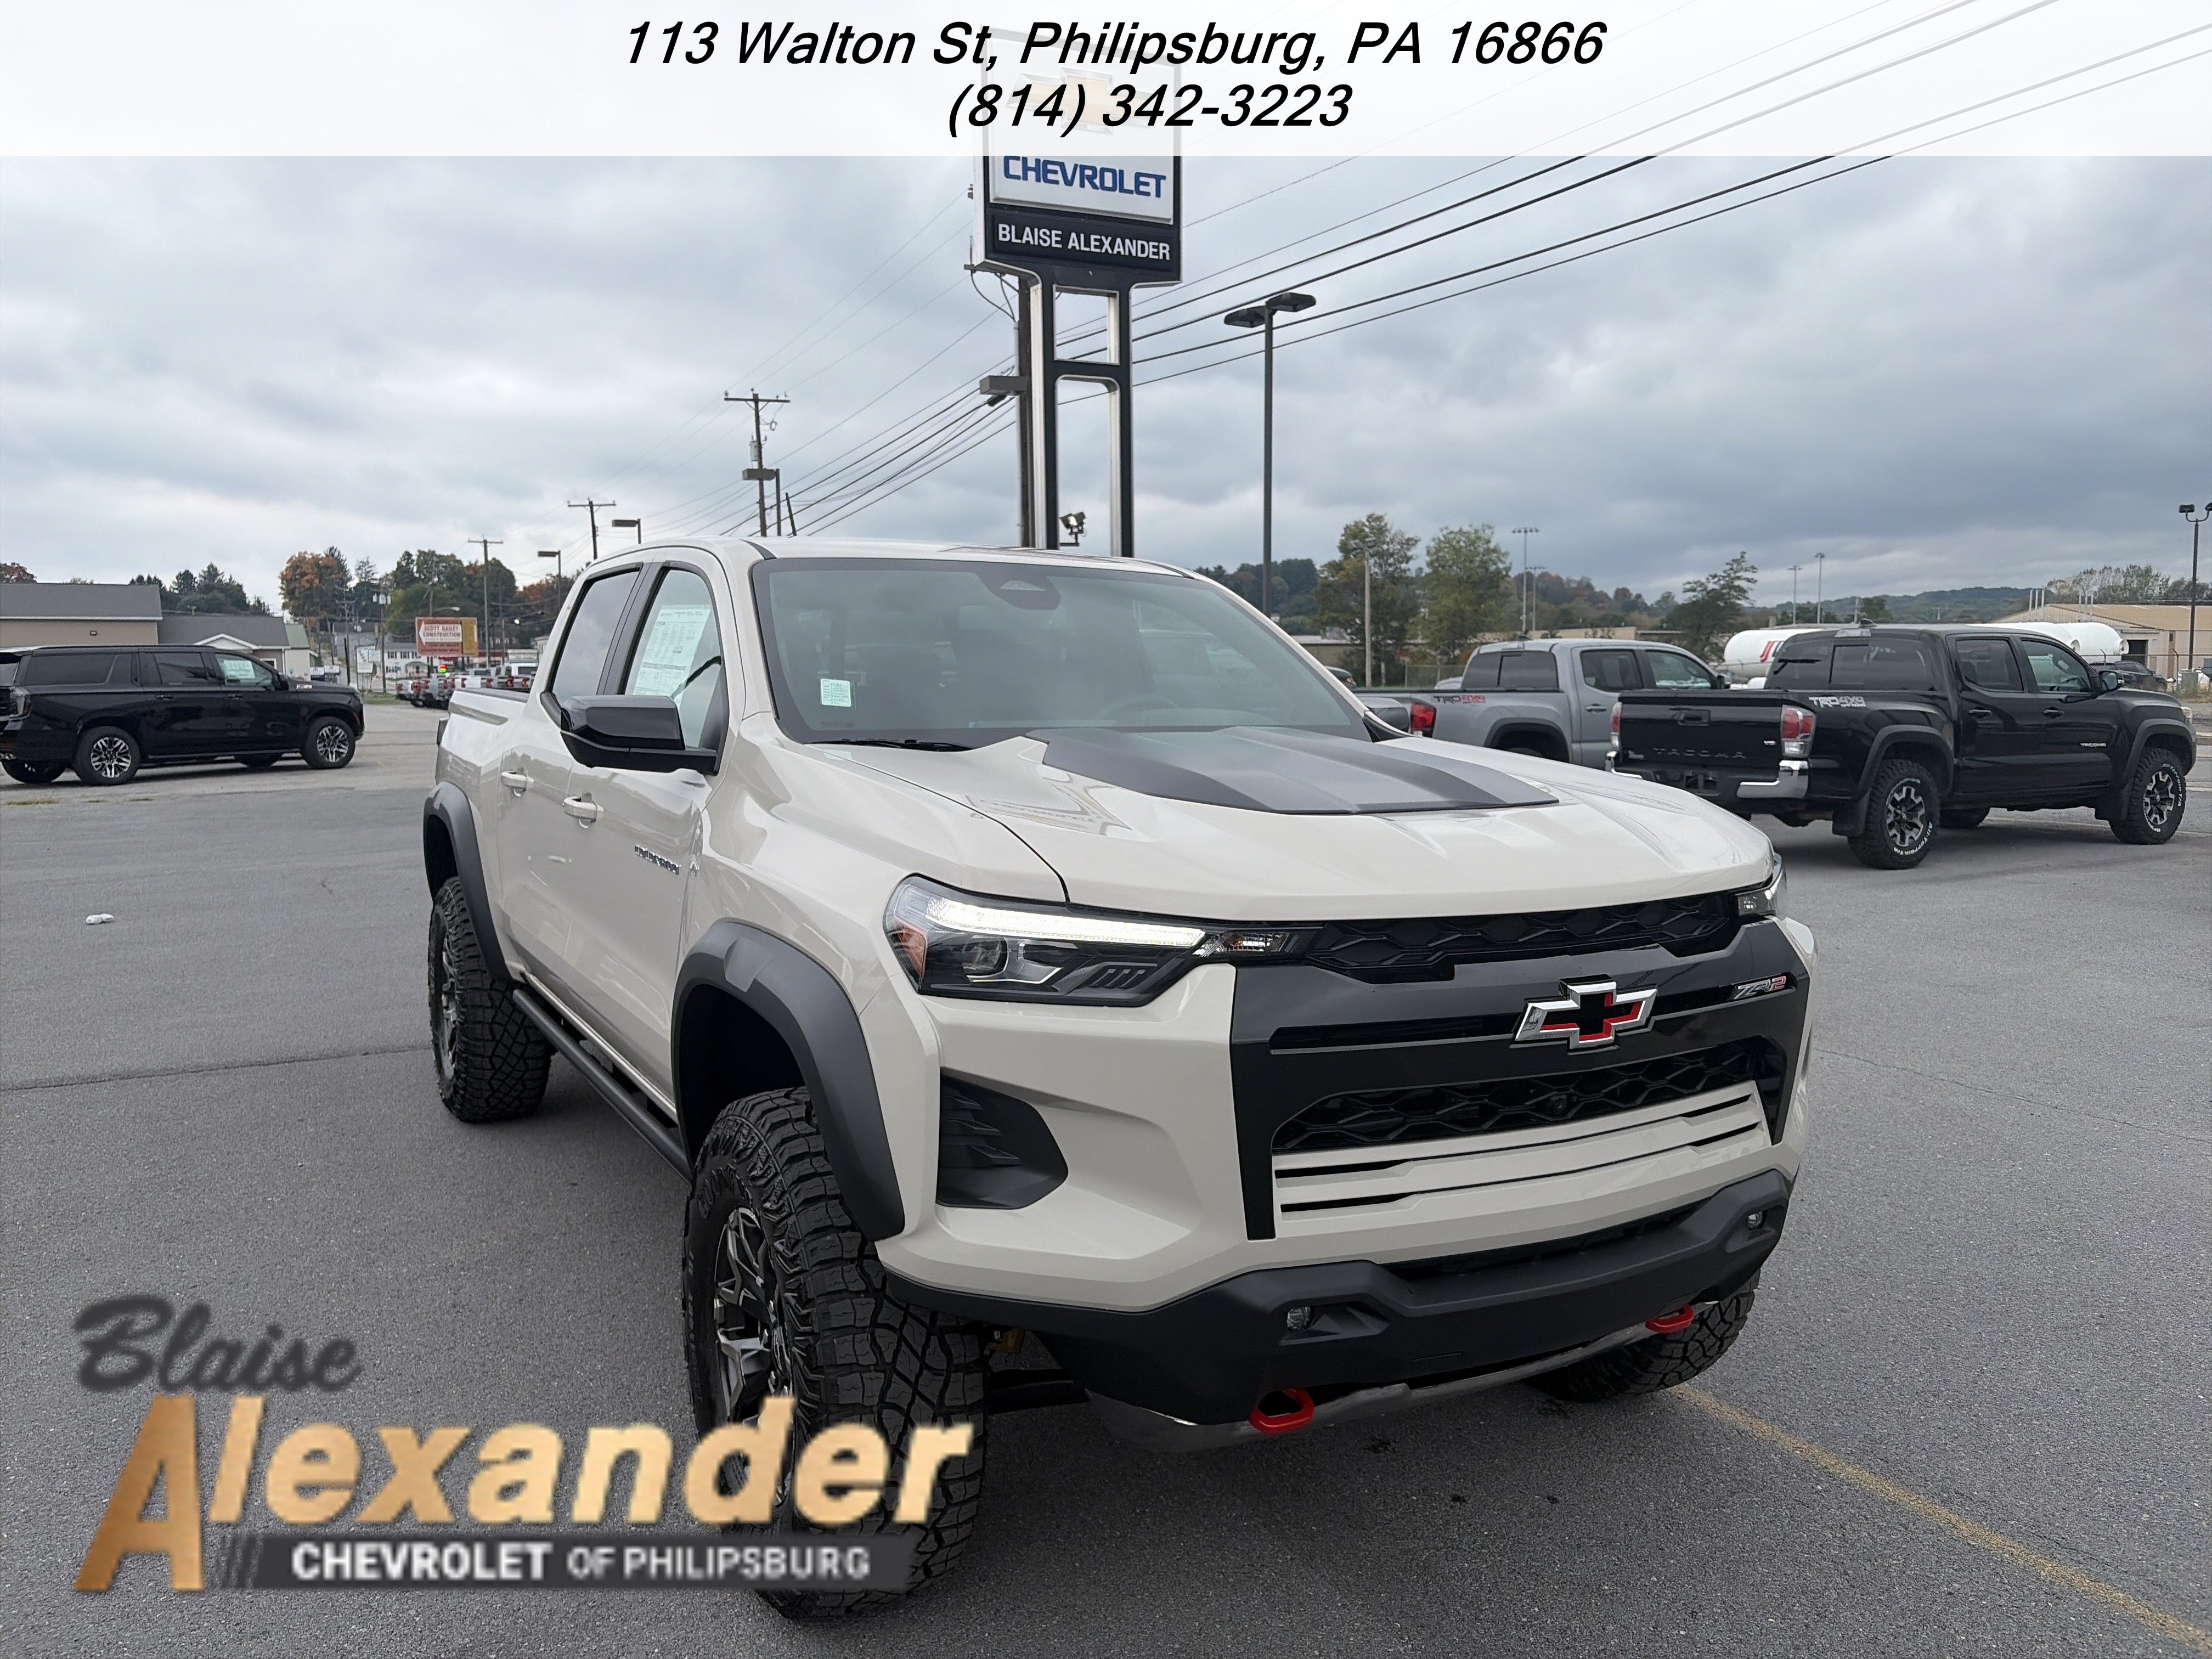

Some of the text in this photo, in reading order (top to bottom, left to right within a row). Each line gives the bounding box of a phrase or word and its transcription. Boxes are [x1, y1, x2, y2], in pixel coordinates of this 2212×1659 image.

[1003, 155, 1167, 198] CHEVROLET
[998, 223, 1171, 261] BLAISE ALEXANDER
[1433, 695, 1462, 704] TRD
[1808, 696, 1840, 708] TRD
[1734, 976, 1786, 1000] ZR2
